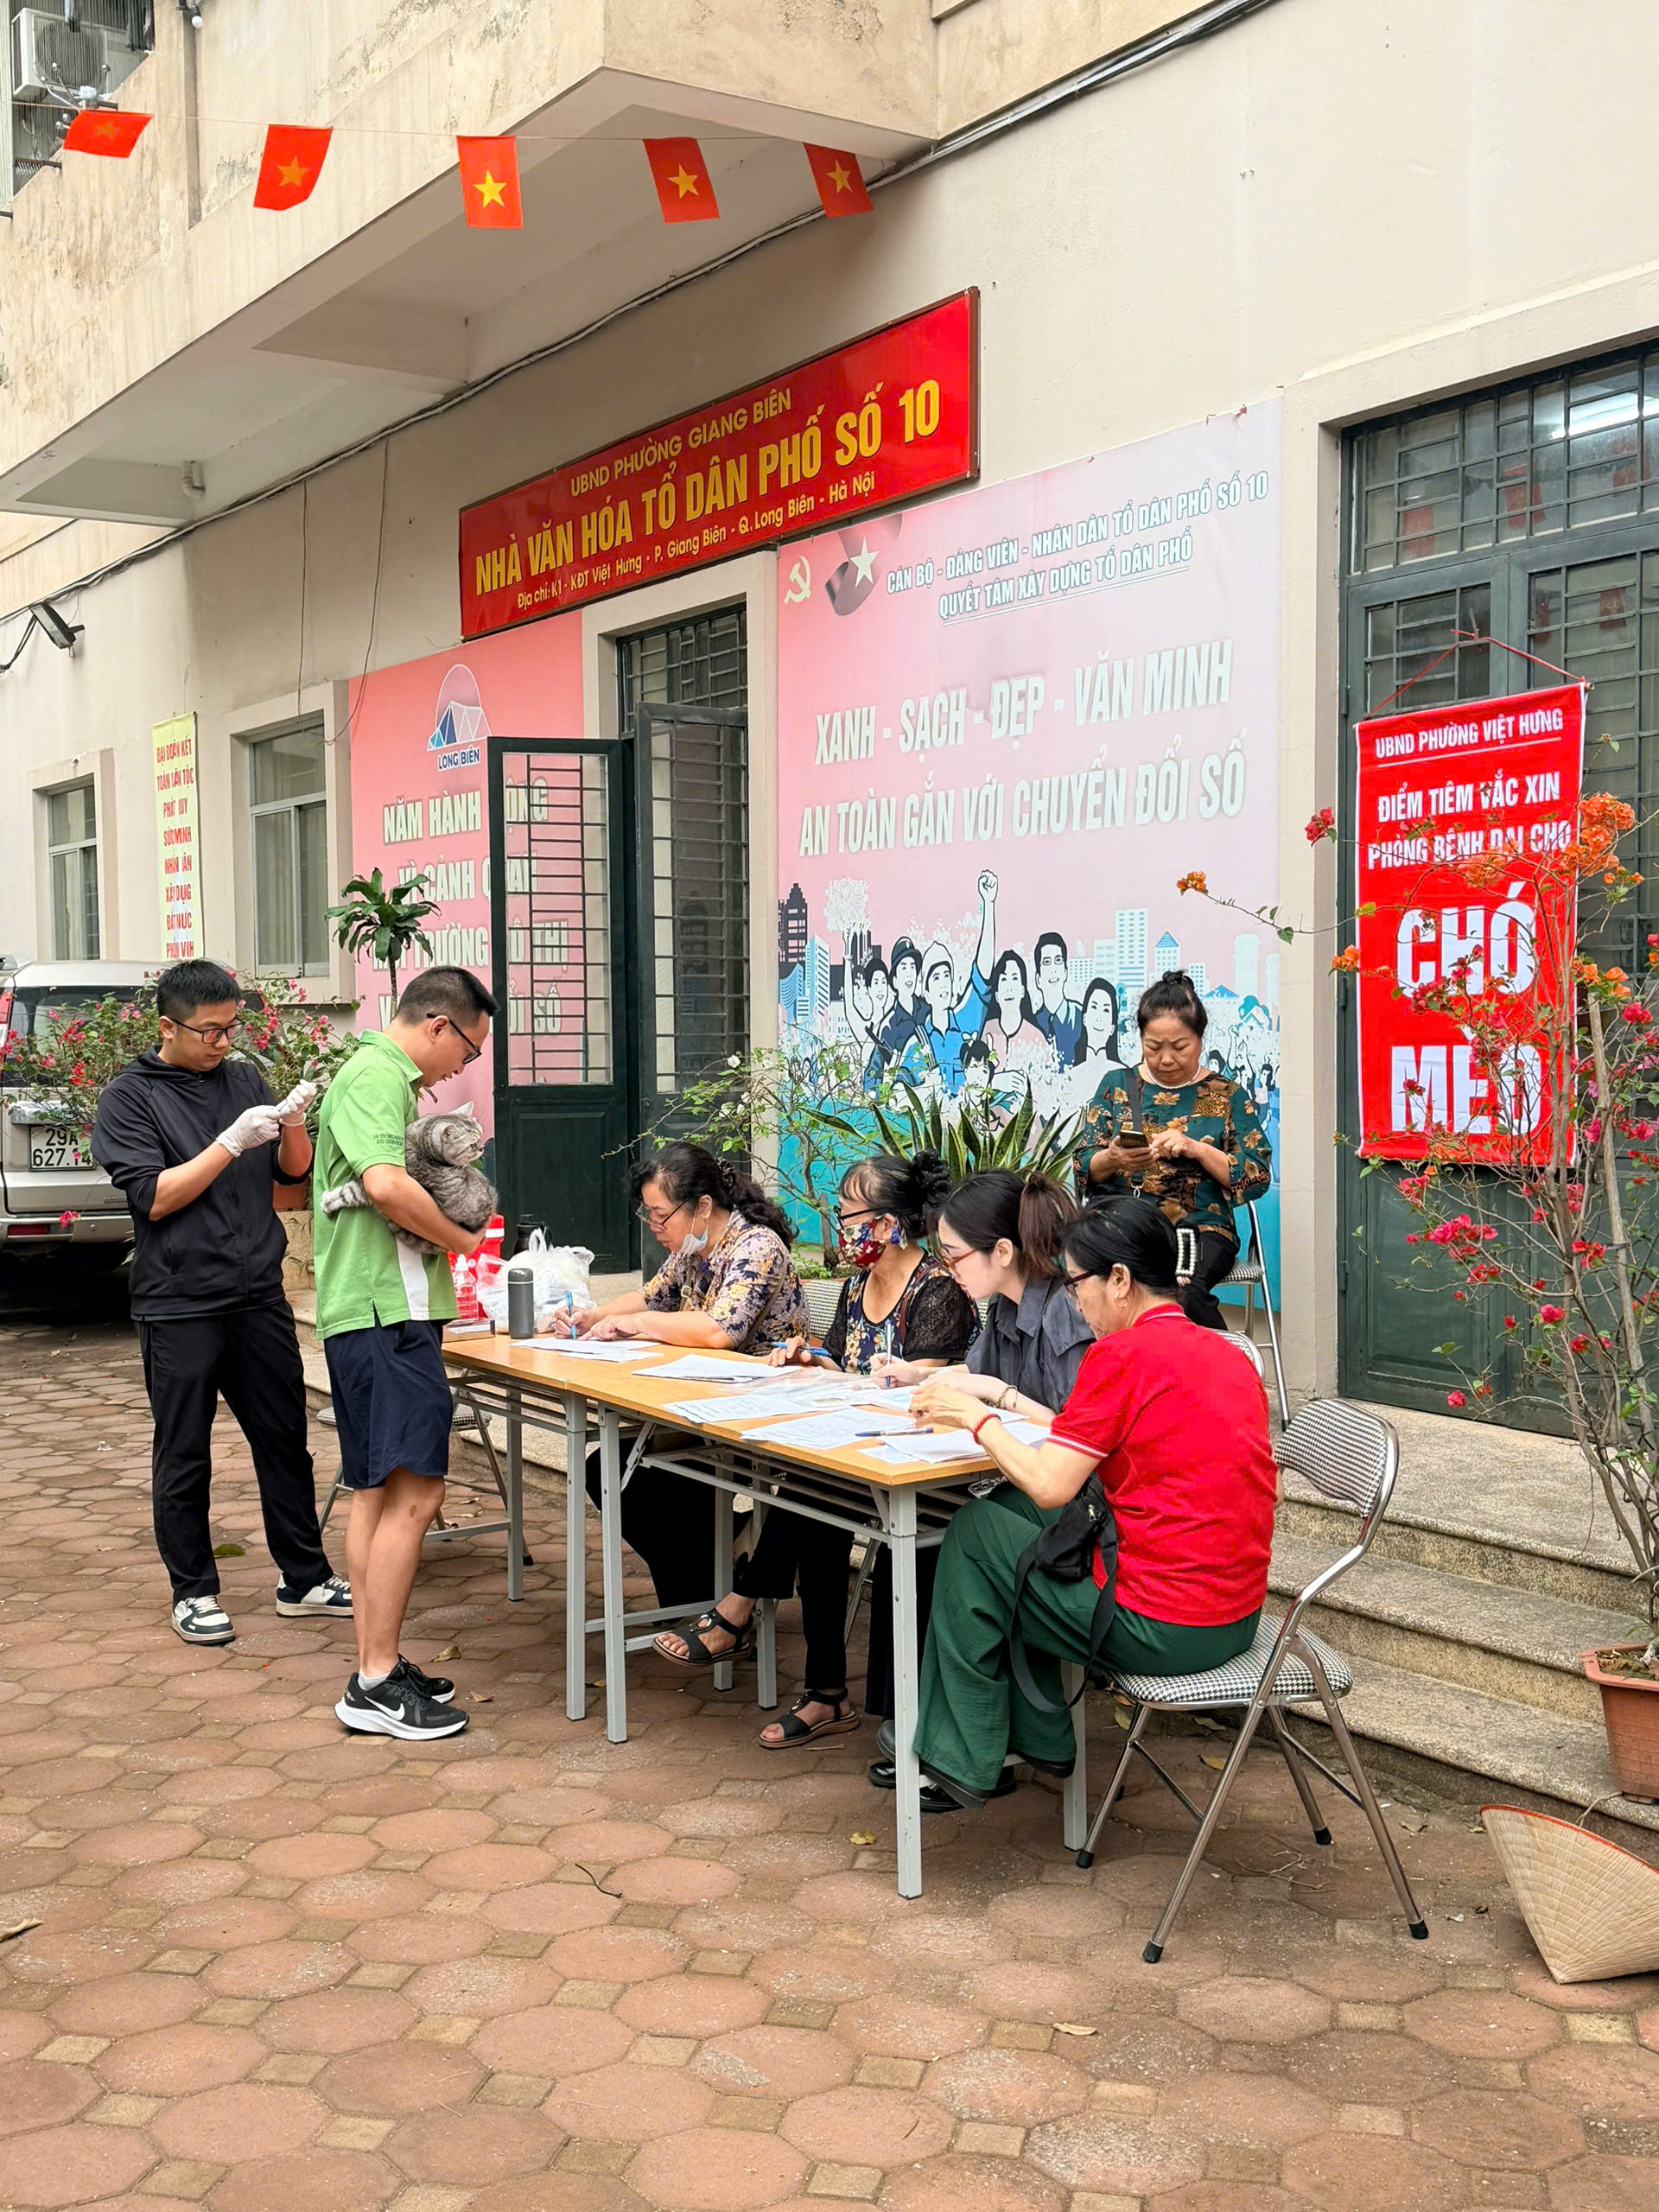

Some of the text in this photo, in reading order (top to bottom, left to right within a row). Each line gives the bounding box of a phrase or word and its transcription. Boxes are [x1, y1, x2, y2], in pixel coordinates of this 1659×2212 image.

[476, 379, 940, 596] NHÀ VĂN HÓA TỔ DÂN PHỐ SỐ 10
[570, 388, 791, 498] UBND PHƯỜNG GIANG BIÊN
[518, 592, 532, 610] Địa
[571, 569, 589, 591] KĐT
[592, 563, 611, 585] Việt
[616, 555, 642, 576] Hưng
[667, 535, 699, 559] Giang
[702, 524, 727, 550] Biên
[754, 507, 784, 531] Long
[788, 495, 815, 518] Biên
[829, 480, 848, 504] Hà
[852, 471, 875, 497] Nội
[887, 566, 912, 594] CÁN
[915, 558, 934, 588] BỘ
[946, 548, 983, 581] ĐẢNG
[986, 537, 1019, 569] VIÊN
[1032, 524, 1073, 557] NHÂN
[1077, 513, 1108, 546] DÂN
[1113, 499, 1134, 537] TỔ
[1138, 497, 1172, 531] DÂN
[1176, 478, 1211, 520] PHỐ
[1217, 470, 1242, 510] SỐ
[1246, 470, 1269, 501] 10
[938, 525, 1193, 620] QUYẾT TÂM XÂY DỰNG TỔ DÂN PHỐ
[815, 705, 876, 765] XANH
[899, 687, 967, 763] SẠCH
[989, 674, 1045, 749] ĐẸP
[1073, 649, 1135, 726] VĂN
[1143, 639, 1232, 715] MINH
[1376, 708, 1563, 759] UBND PHƯỜNG VIỆT HƯNG
[438, 745, 480, 770] LONG BIÊN
[798, 727, 1250, 856] AN TOÀN GẮN VỚI CHUYỂN ĐỔI SỐ
[1377, 768, 1560, 823] ĐIỂM TIÊM VẮC XIN
[384, 797, 423, 843] NĂM
[429, 790, 481, 837] HÀNH
[1368, 834, 1428, 869] PHÒNG
[423, 854, 475, 903] CẢNH
[1396, 881, 1537, 999] CHÓ
[1391, 1023, 1542, 1135] MÈO
